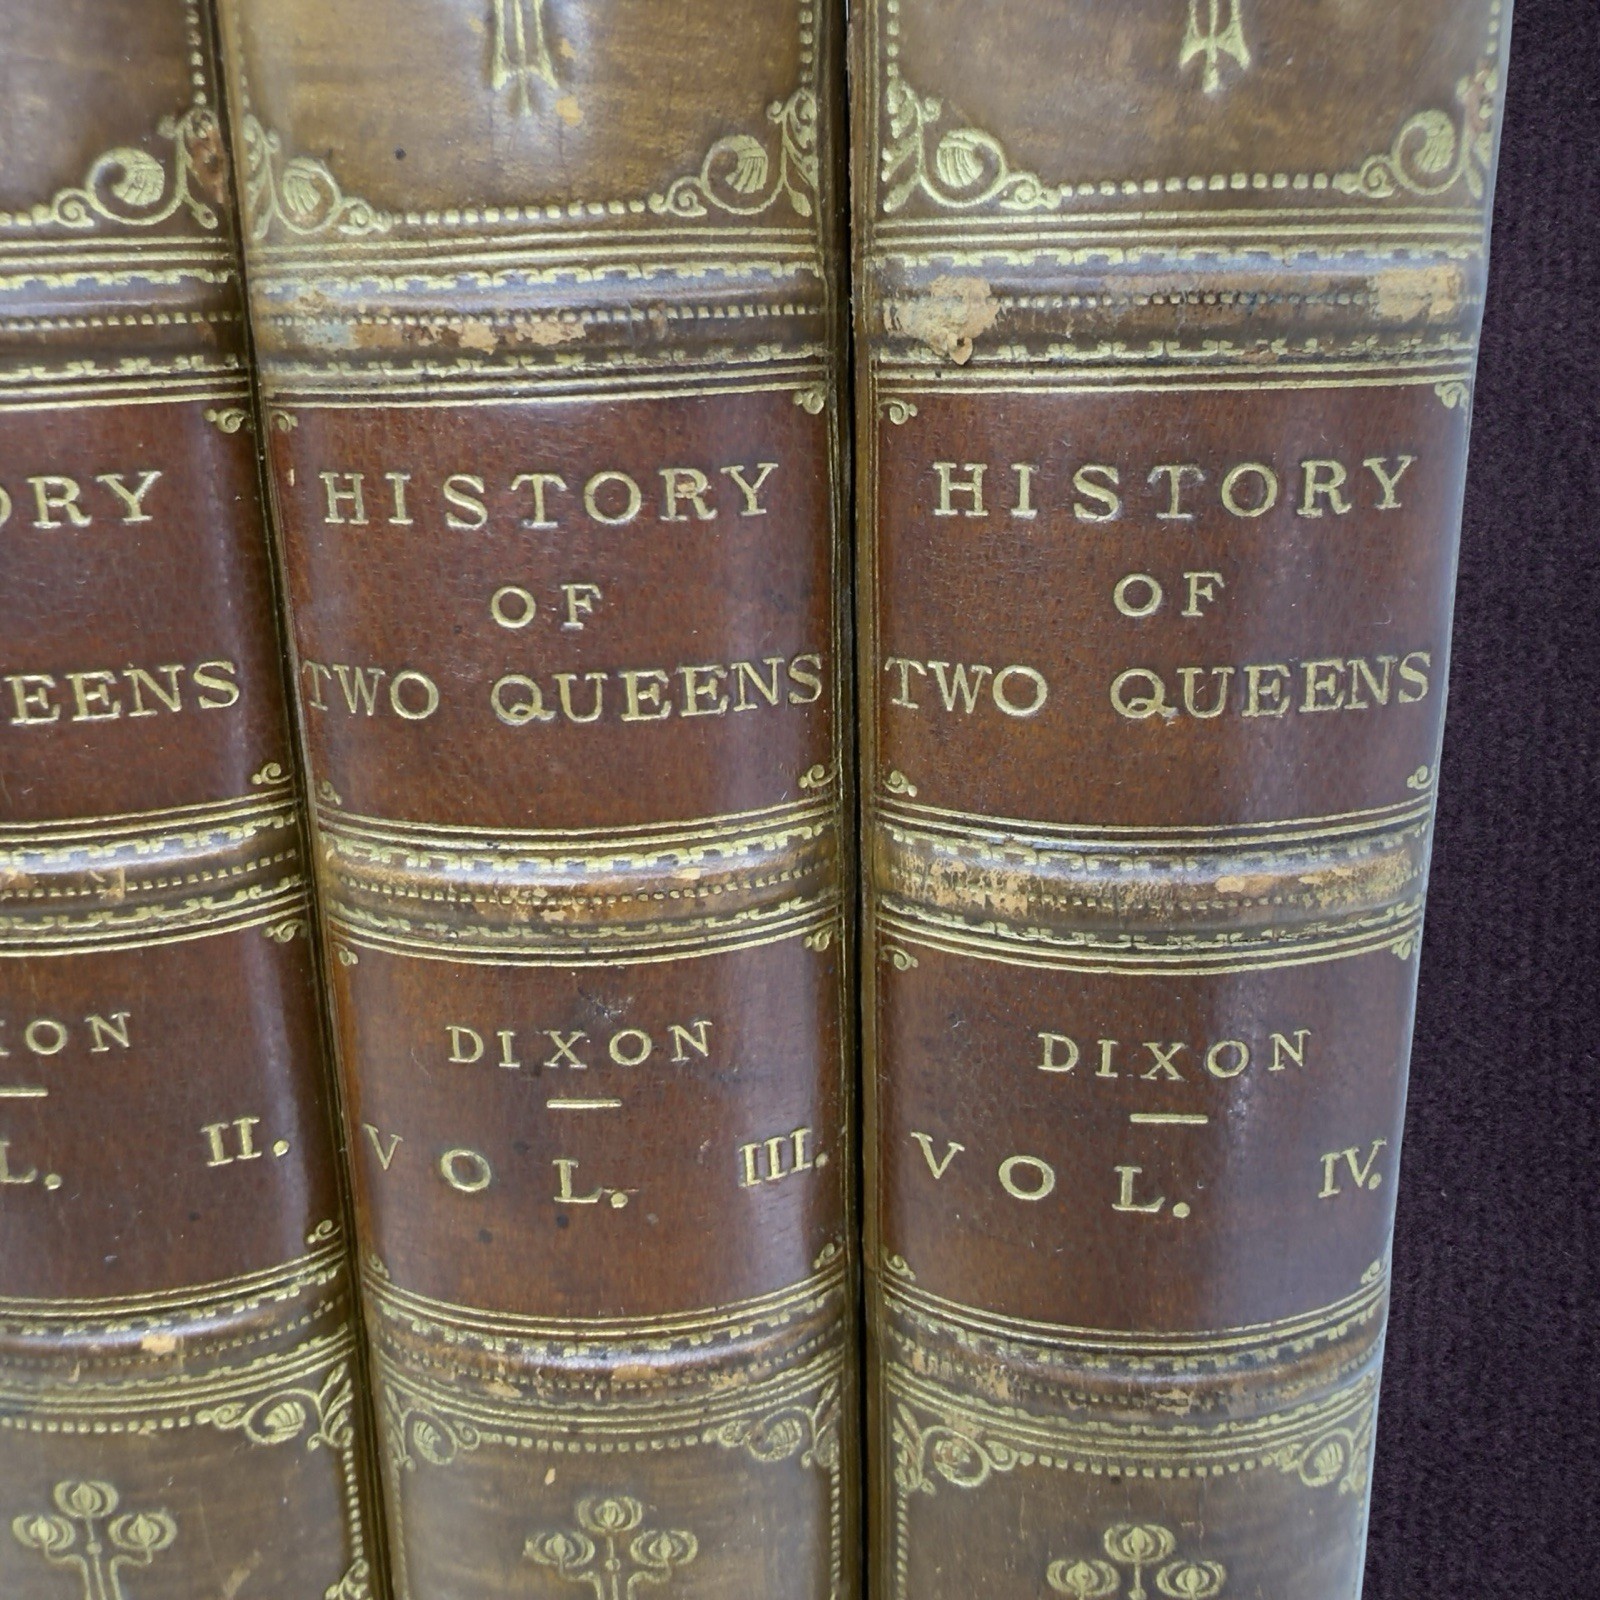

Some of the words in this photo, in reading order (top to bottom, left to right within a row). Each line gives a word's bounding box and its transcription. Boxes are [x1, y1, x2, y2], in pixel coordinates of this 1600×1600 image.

[0, 471, 162, 529] RY
[319, 462, 779, 530] HISTORY
[932, 455, 1418, 522] HISTORY
[491, 583, 601, 630] OF
[1113, 571, 1225, 618] OF
[302, 659, 440, 720] TWO
[491, 652, 823, 726] QUEENS
[885, 656, 1049, 717] TWO
[1109, 651, 1432, 721] QUEENS
[0, 1011, 131, 1056] ON
[445, 1020, 713, 1069] DIXON
[1038, 1029, 1311, 1082] DIXON
[200, 1116, 290, 1167] II.
[362, 1123, 629, 1208] VOL.
[738, 1126, 829, 1188] III.
[910, 1131, 1191, 1219] VOL.
[1317, 1138, 1387, 1198] IV.
